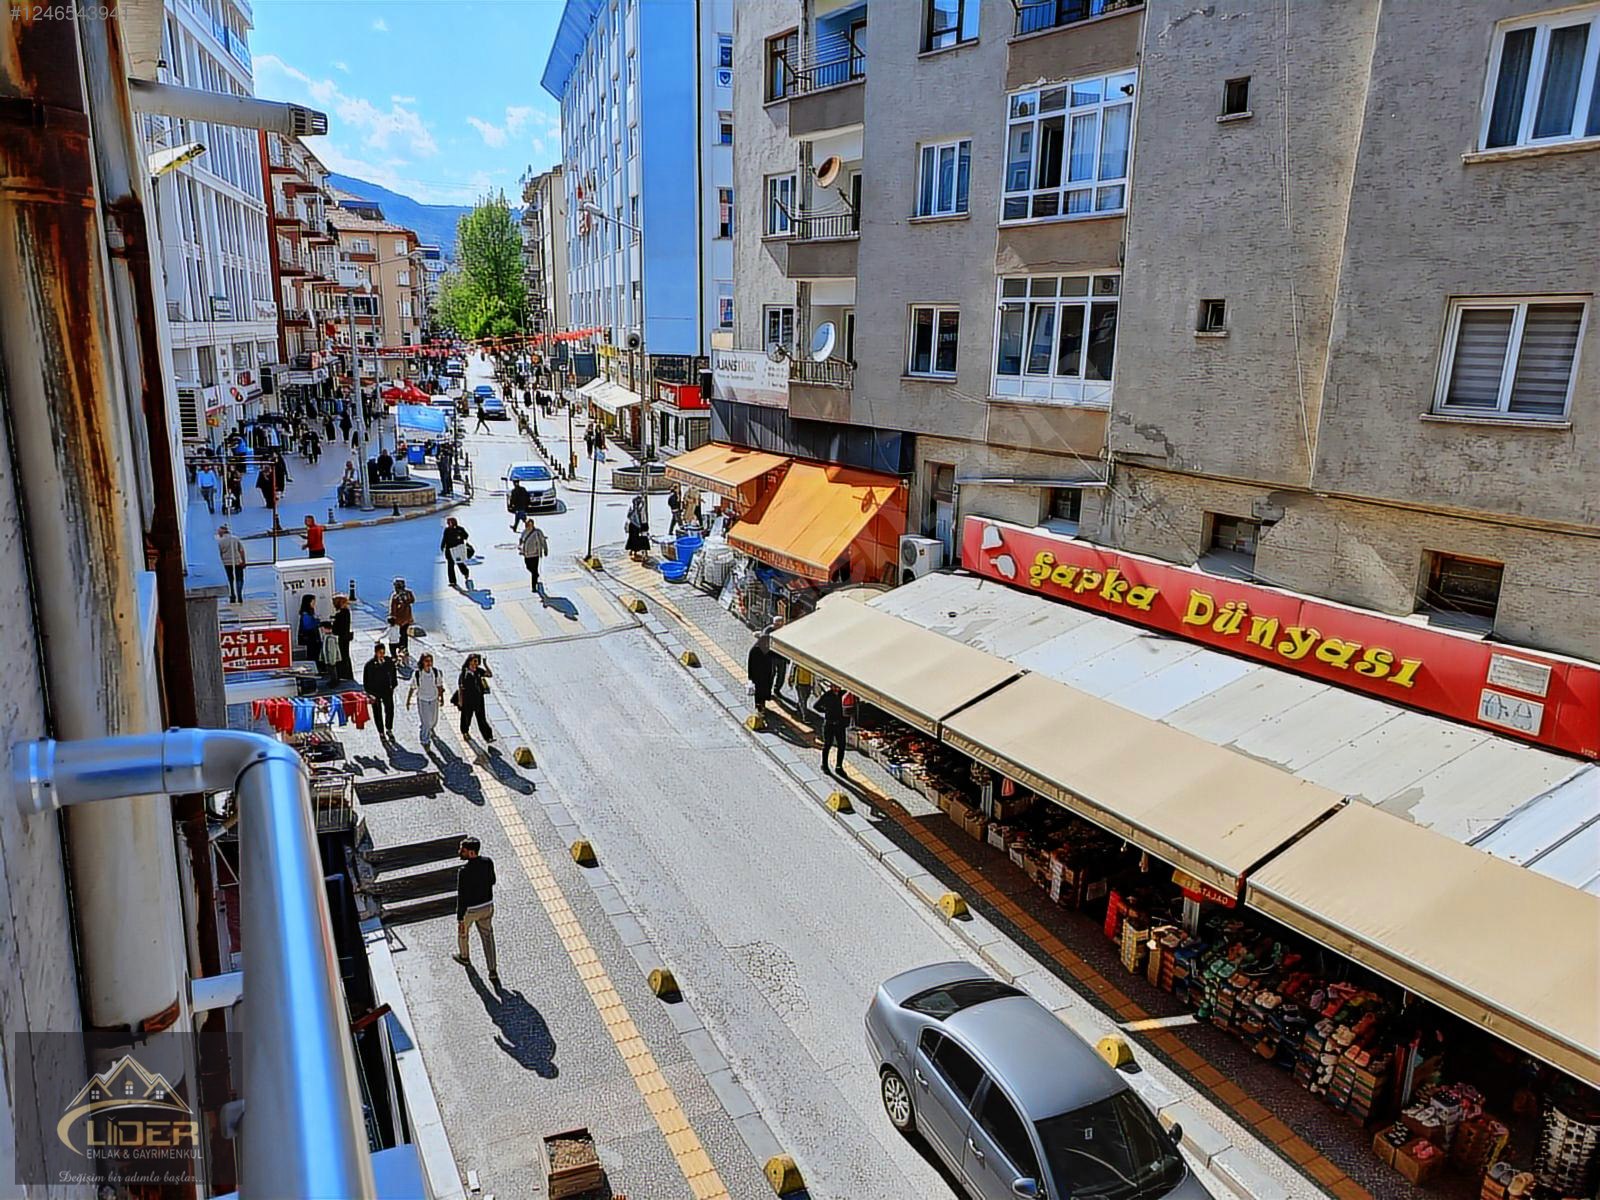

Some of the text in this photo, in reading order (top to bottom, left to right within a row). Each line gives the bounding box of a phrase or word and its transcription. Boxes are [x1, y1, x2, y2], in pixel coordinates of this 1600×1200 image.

[221, 645, 283, 657] MLAK
[1029, 551, 1159, 611] Şapka
[1182, 589, 1422, 688] Dünyası
